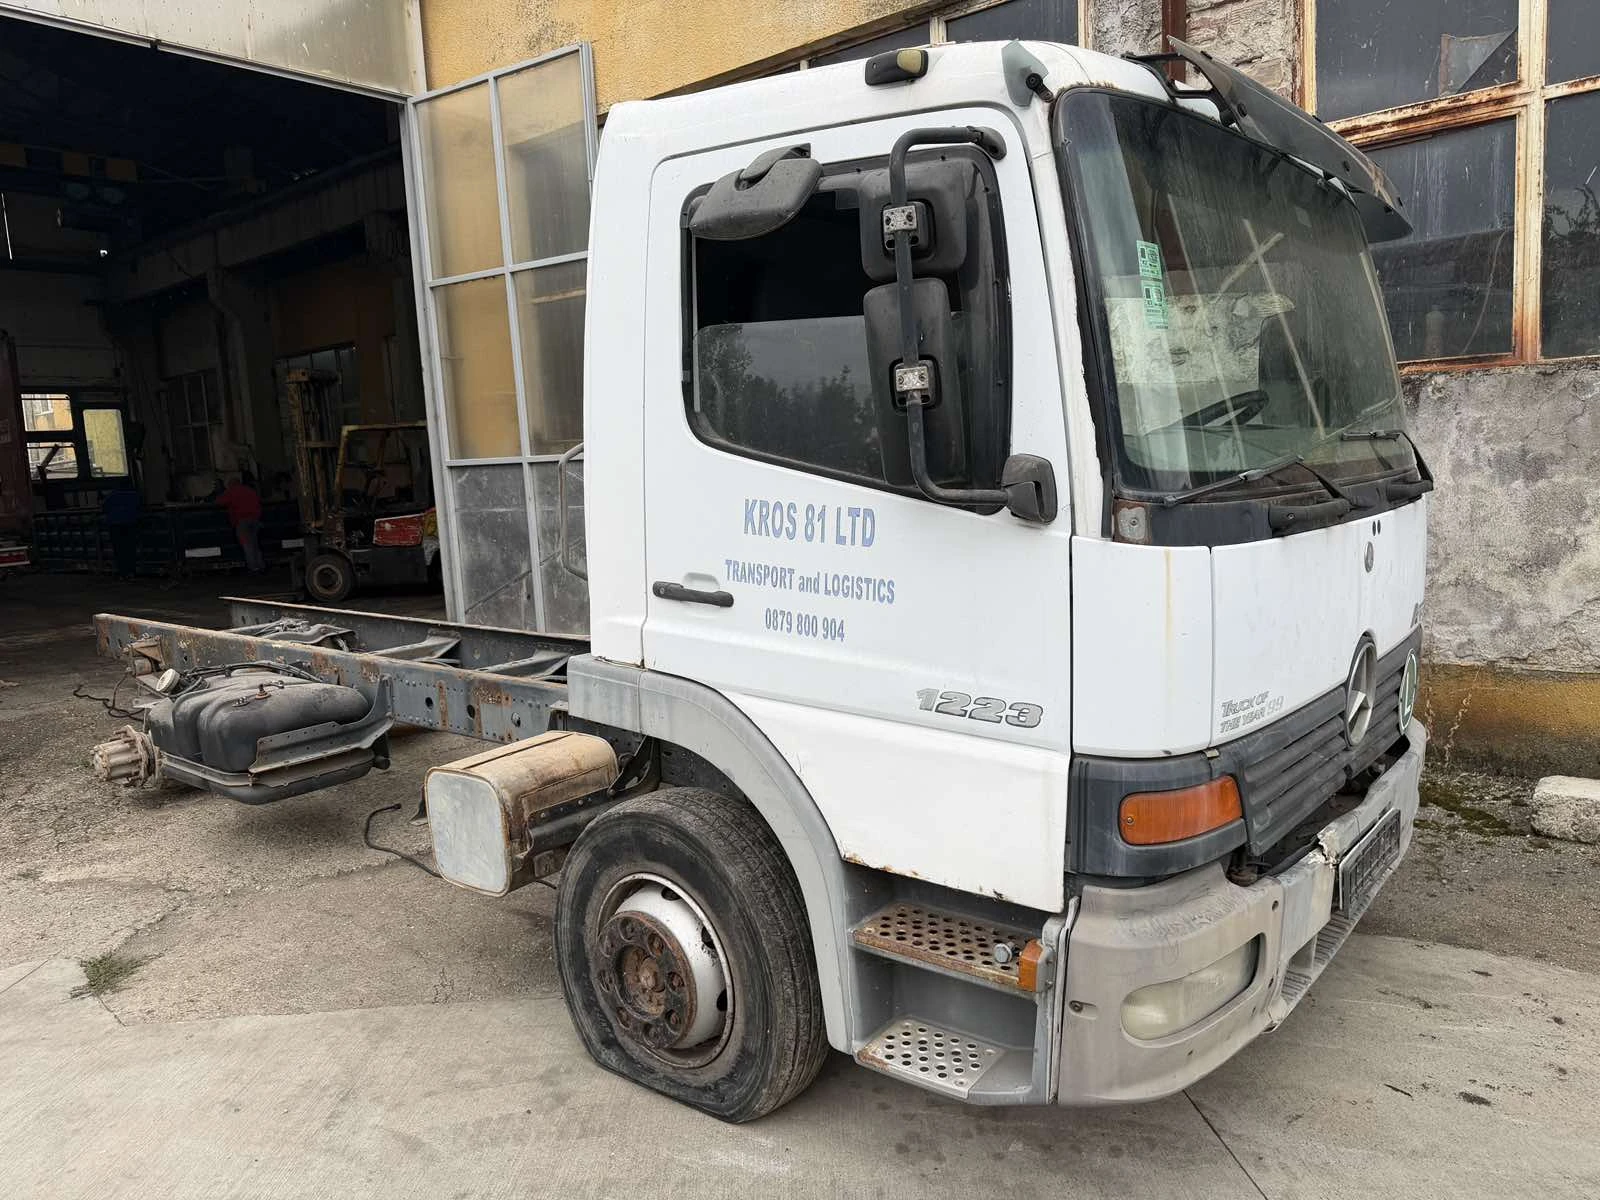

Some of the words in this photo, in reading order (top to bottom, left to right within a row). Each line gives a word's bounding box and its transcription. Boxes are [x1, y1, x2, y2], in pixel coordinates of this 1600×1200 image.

[744, 498, 797, 540] KROS
[804, 503, 827, 543] 81
[836, 506, 876, 547] LTD
[725, 559, 795, 590] TRANSPORT
[798, 572, 820, 595] and
[824, 573, 895, 604] LOGISTICS
[765, 607, 793, 633] 0879
[796, 613, 818, 637] 800
[822, 617, 845, 642] 904
[916, 688, 1044, 728] 1223
